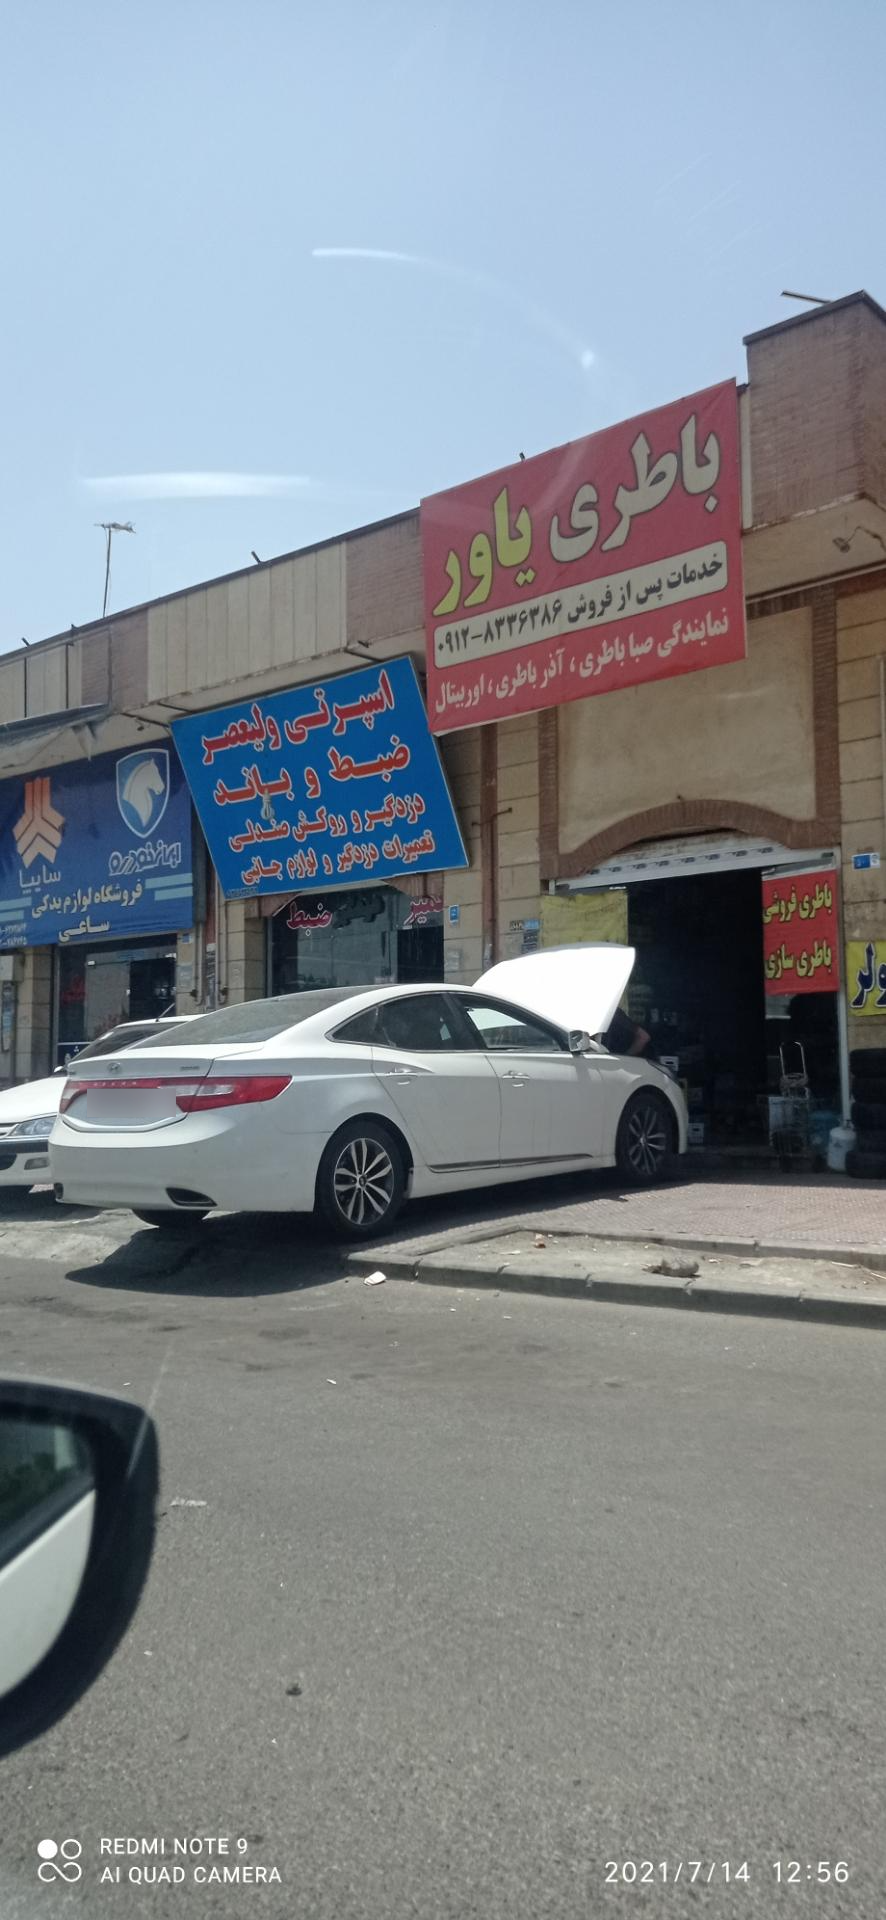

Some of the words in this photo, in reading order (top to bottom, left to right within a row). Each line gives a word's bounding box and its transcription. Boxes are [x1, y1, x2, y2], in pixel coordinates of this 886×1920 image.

[550, 413, 720, 564] باطری
[433, 488, 536, 616] یاور
[667, 553, 723, 589] خدمات
[567, 585, 612, 623] فروش
[618, 581, 631, 611] از
[636, 577, 662, 604] پس
[629, 625, 654, 663] صبا
[657, 607, 728, 657] نمایندگی
[541, 648, 565, 688] آذر
[579, 636, 625, 678] باطری
[435, 675, 484, 713] اوربیتال
[496, 660, 537, 699] باطری
[284, 669, 394, 743] اسپرتی
[202, 703, 281, 764] ولیعصر
[328, 735, 410, 782] ضبط
[213, 764, 295, 805] باند
[304, 766, 320, 798] و
[292, 806, 347, 841] روکش
[352, 809, 362, 832] و
[364, 793, 425, 829] دزدگیر
[229, 817, 289, 851] صندلی
[383, 830, 435, 863] تعمیرات
[242, 857, 283, 885] جانبی
[287, 848, 317, 880] لوازم
[323, 854, 333, 874] و
[337, 841, 378, 871] دزدگیر
[19, 864, 61, 894] سایپا
[94, 878, 143, 906] فروشگاه
[32, 894, 61, 918] یدکی
[63, 887, 92, 913] لوازم
[763, 887, 797, 924] فروشی
[799, 883, 832, 919] باطری
[58, 915, 110, 942] ساعی
[287, 901, 333, 936] ضبط
[766, 944, 794, 979] سازی
[797, 940, 832, 976] باطری
